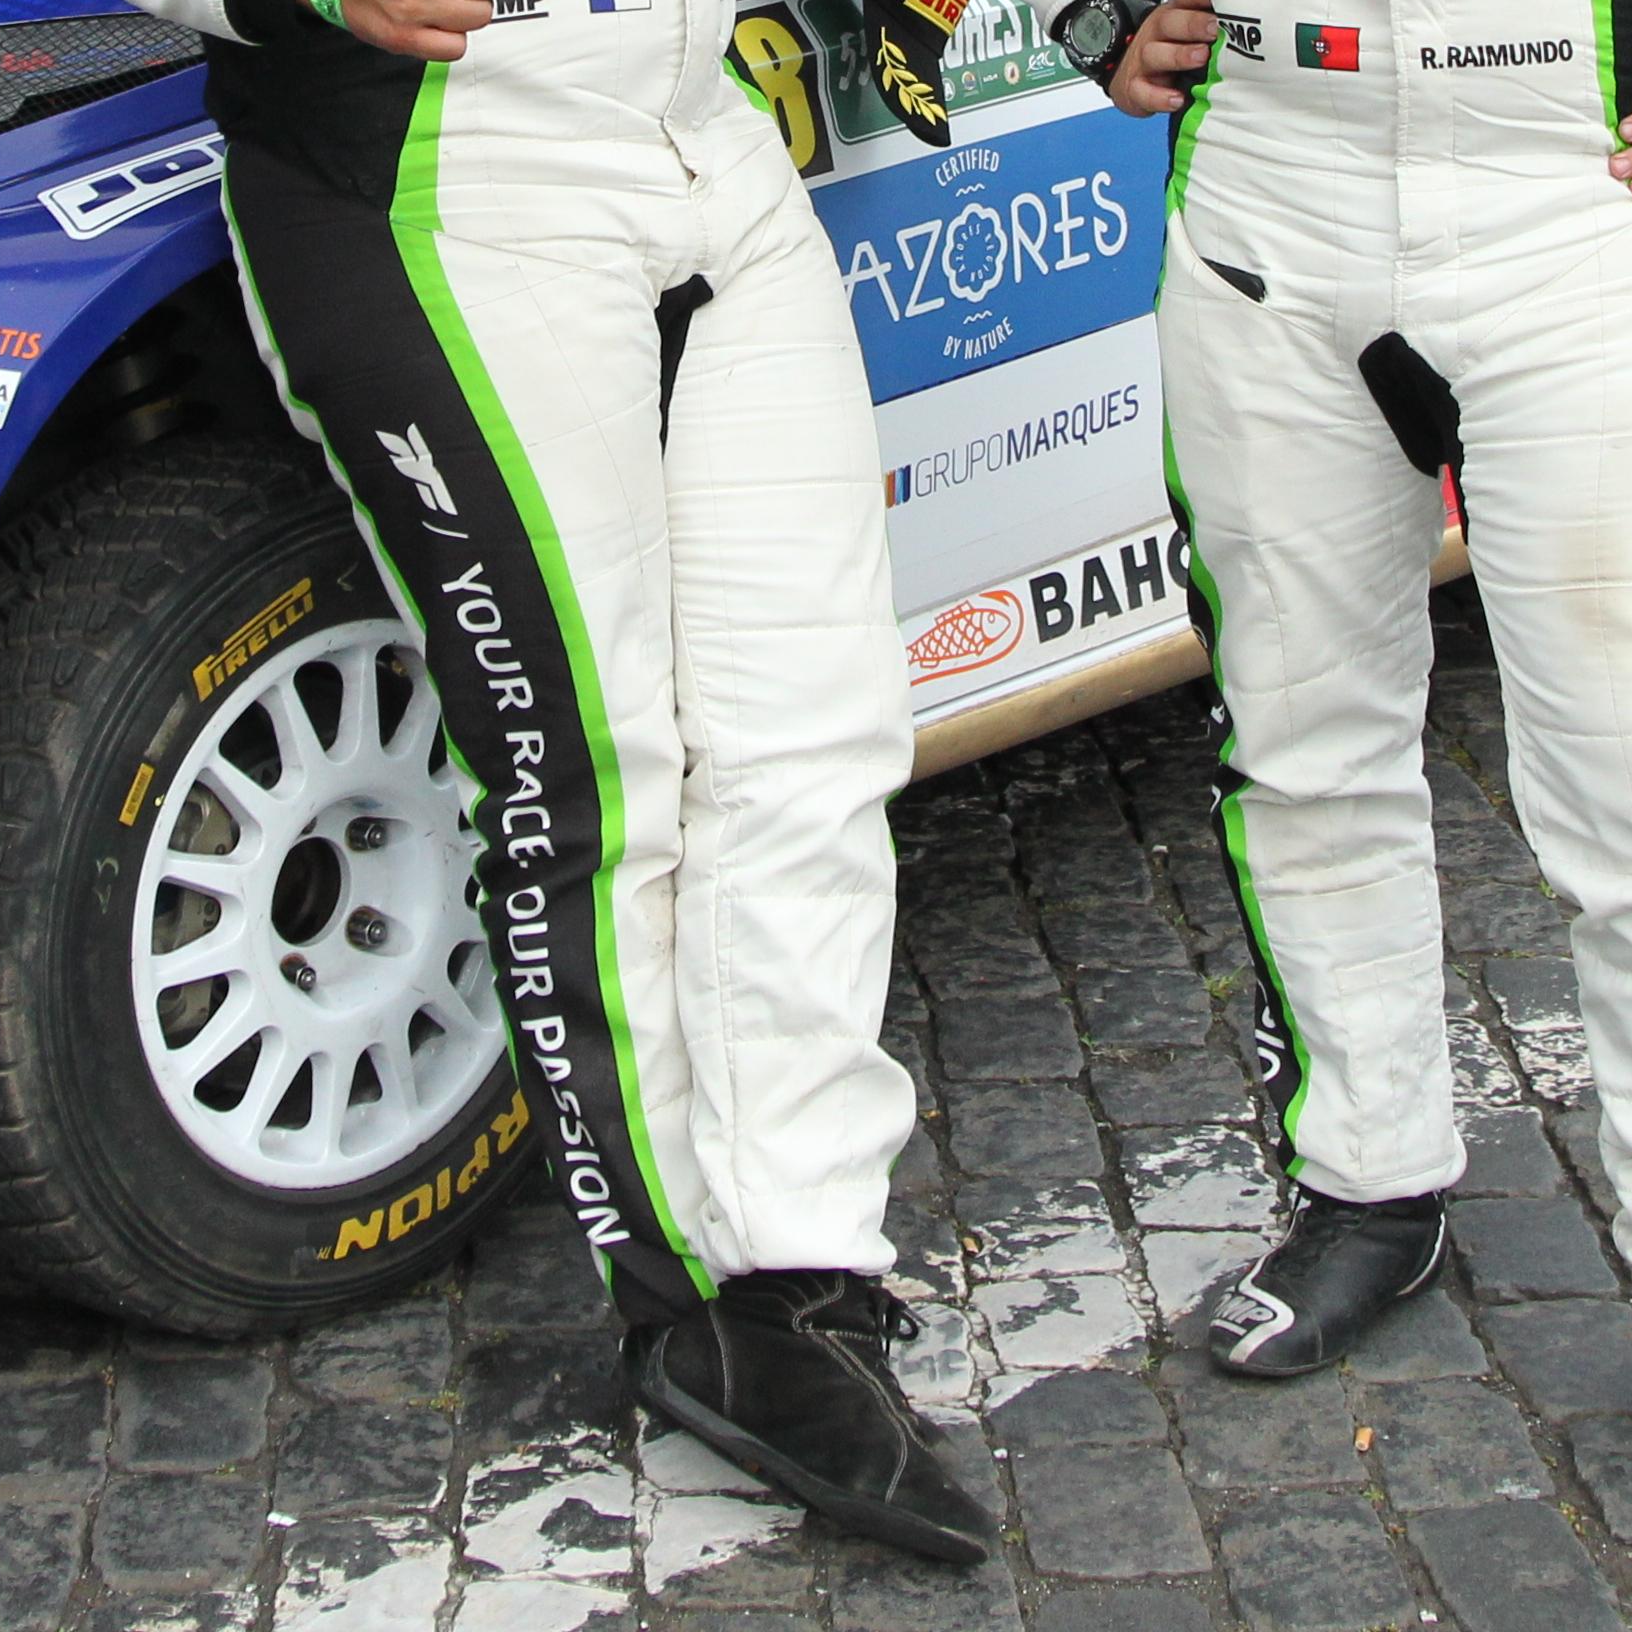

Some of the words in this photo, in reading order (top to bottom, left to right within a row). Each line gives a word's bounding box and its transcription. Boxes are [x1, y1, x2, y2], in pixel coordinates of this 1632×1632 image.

[935, 148, 1000, 187] CERTIFIED
[844, 170, 1128, 322] AZORES
[943, 335, 962, 359] BY
[964, 316, 1014, 360] NATURE
[192, 576, 315, 703] PIRELLI
[440, 560, 536, 714] YOUR
[504, 884, 556, 1002] OUR
[520, 1017, 631, 1252] PASSION
[1215, 1292, 1275, 1327] OMP
